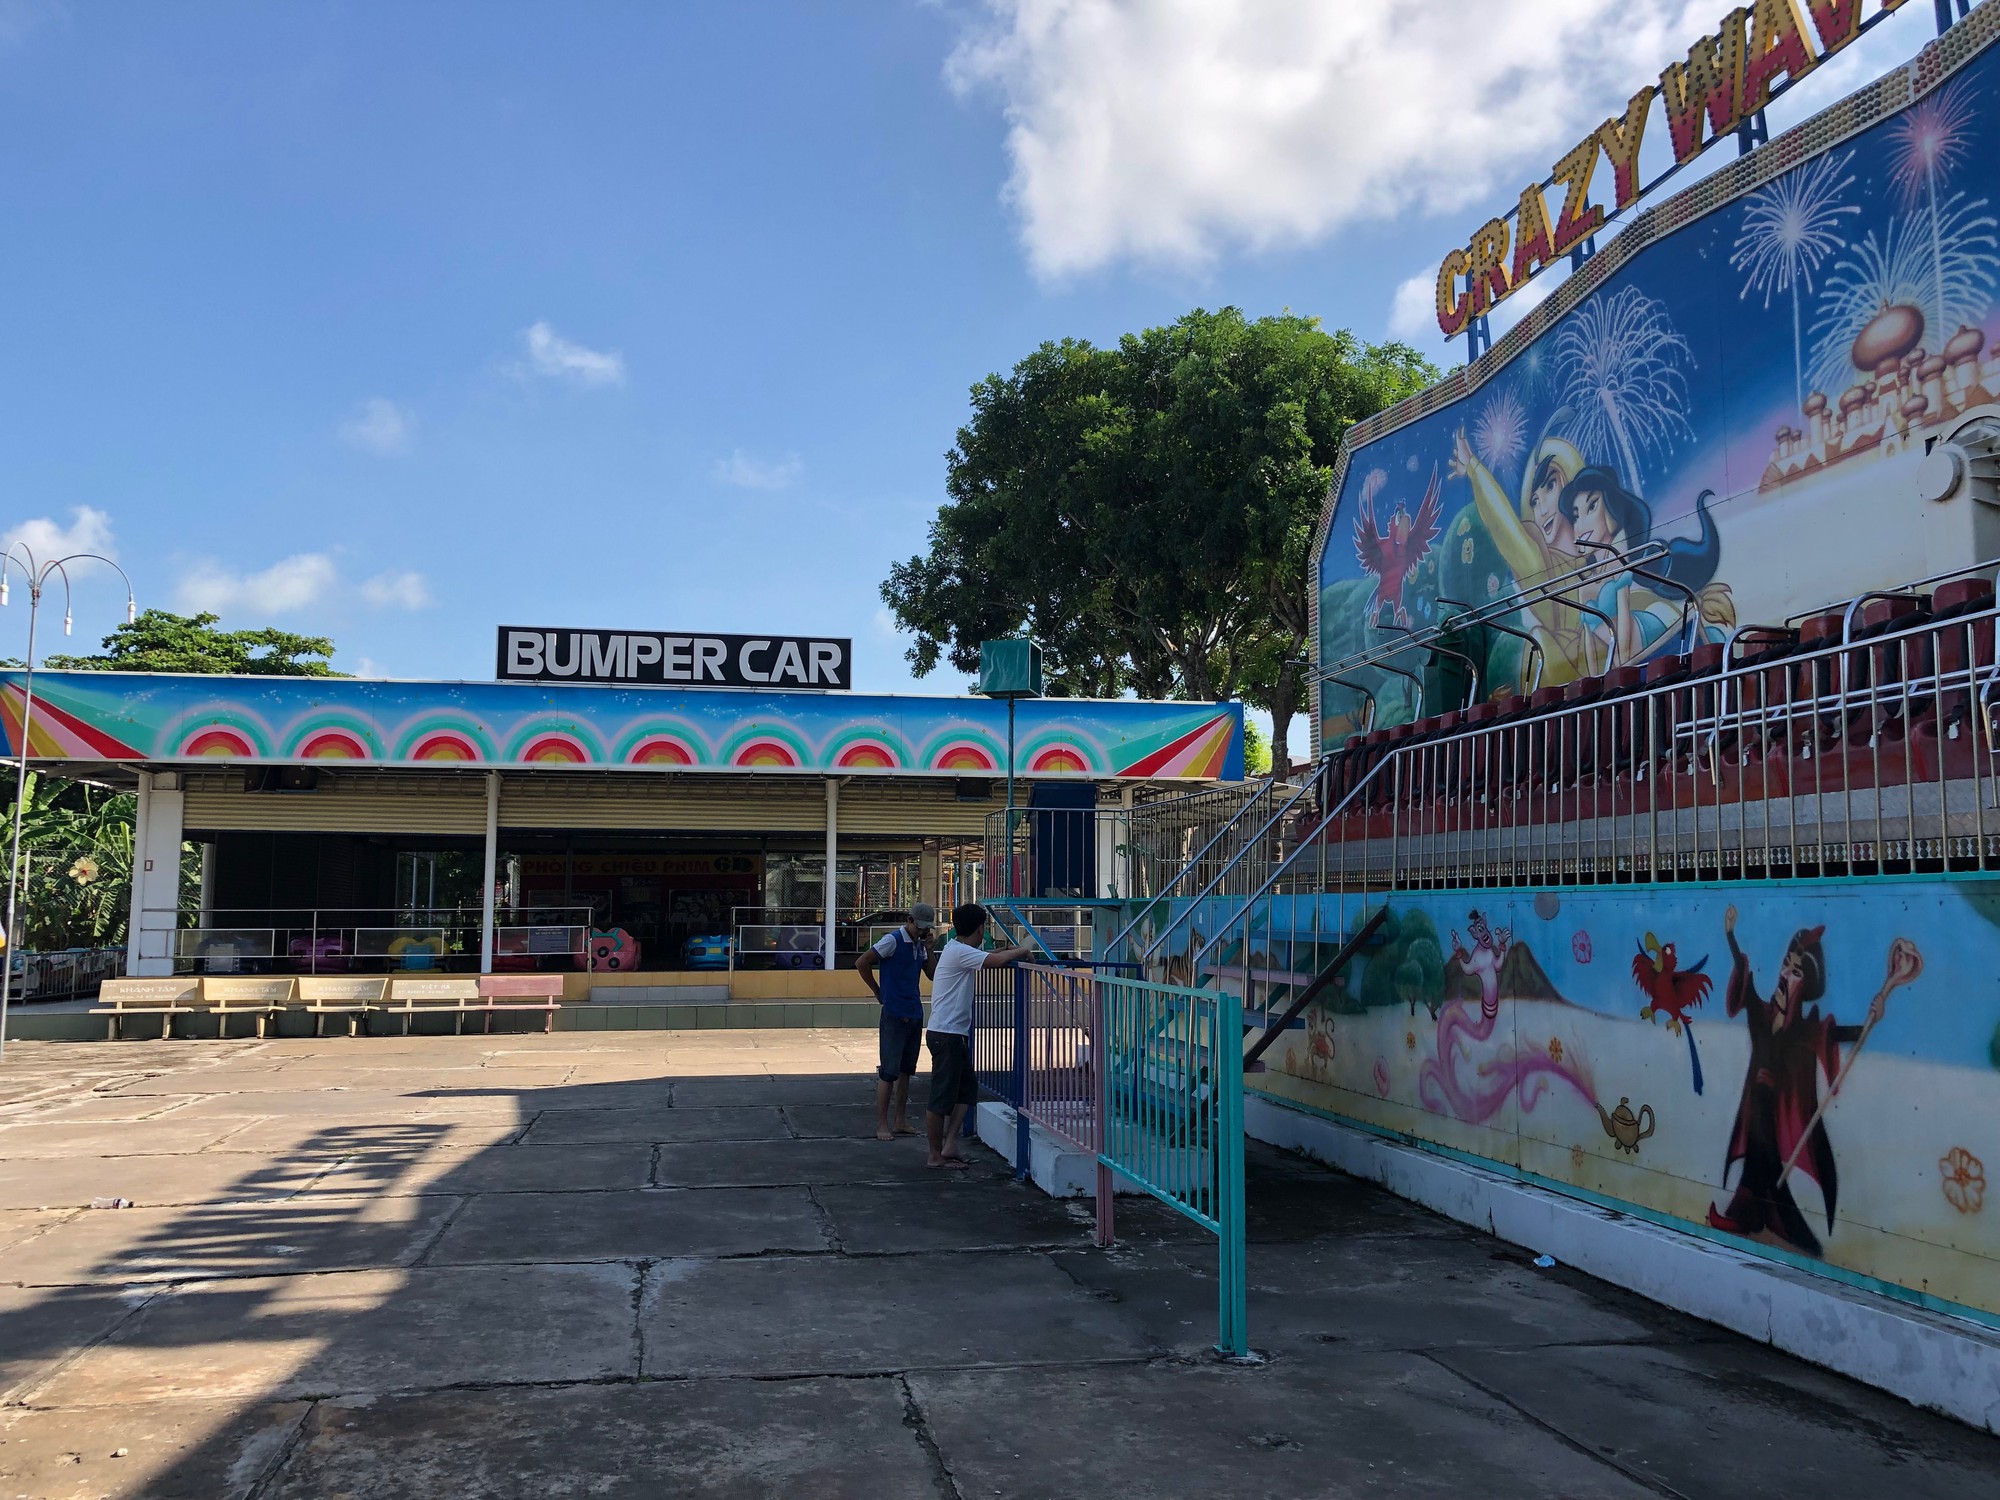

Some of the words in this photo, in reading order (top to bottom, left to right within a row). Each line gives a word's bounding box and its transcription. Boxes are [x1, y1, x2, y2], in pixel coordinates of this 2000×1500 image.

[1436, 86, 1654, 335] CRAZY
[507, 631, 728, 681] BUMPER
[739, 640, 842, 684] CAR
[663, 860, 710, 872] PHIM
